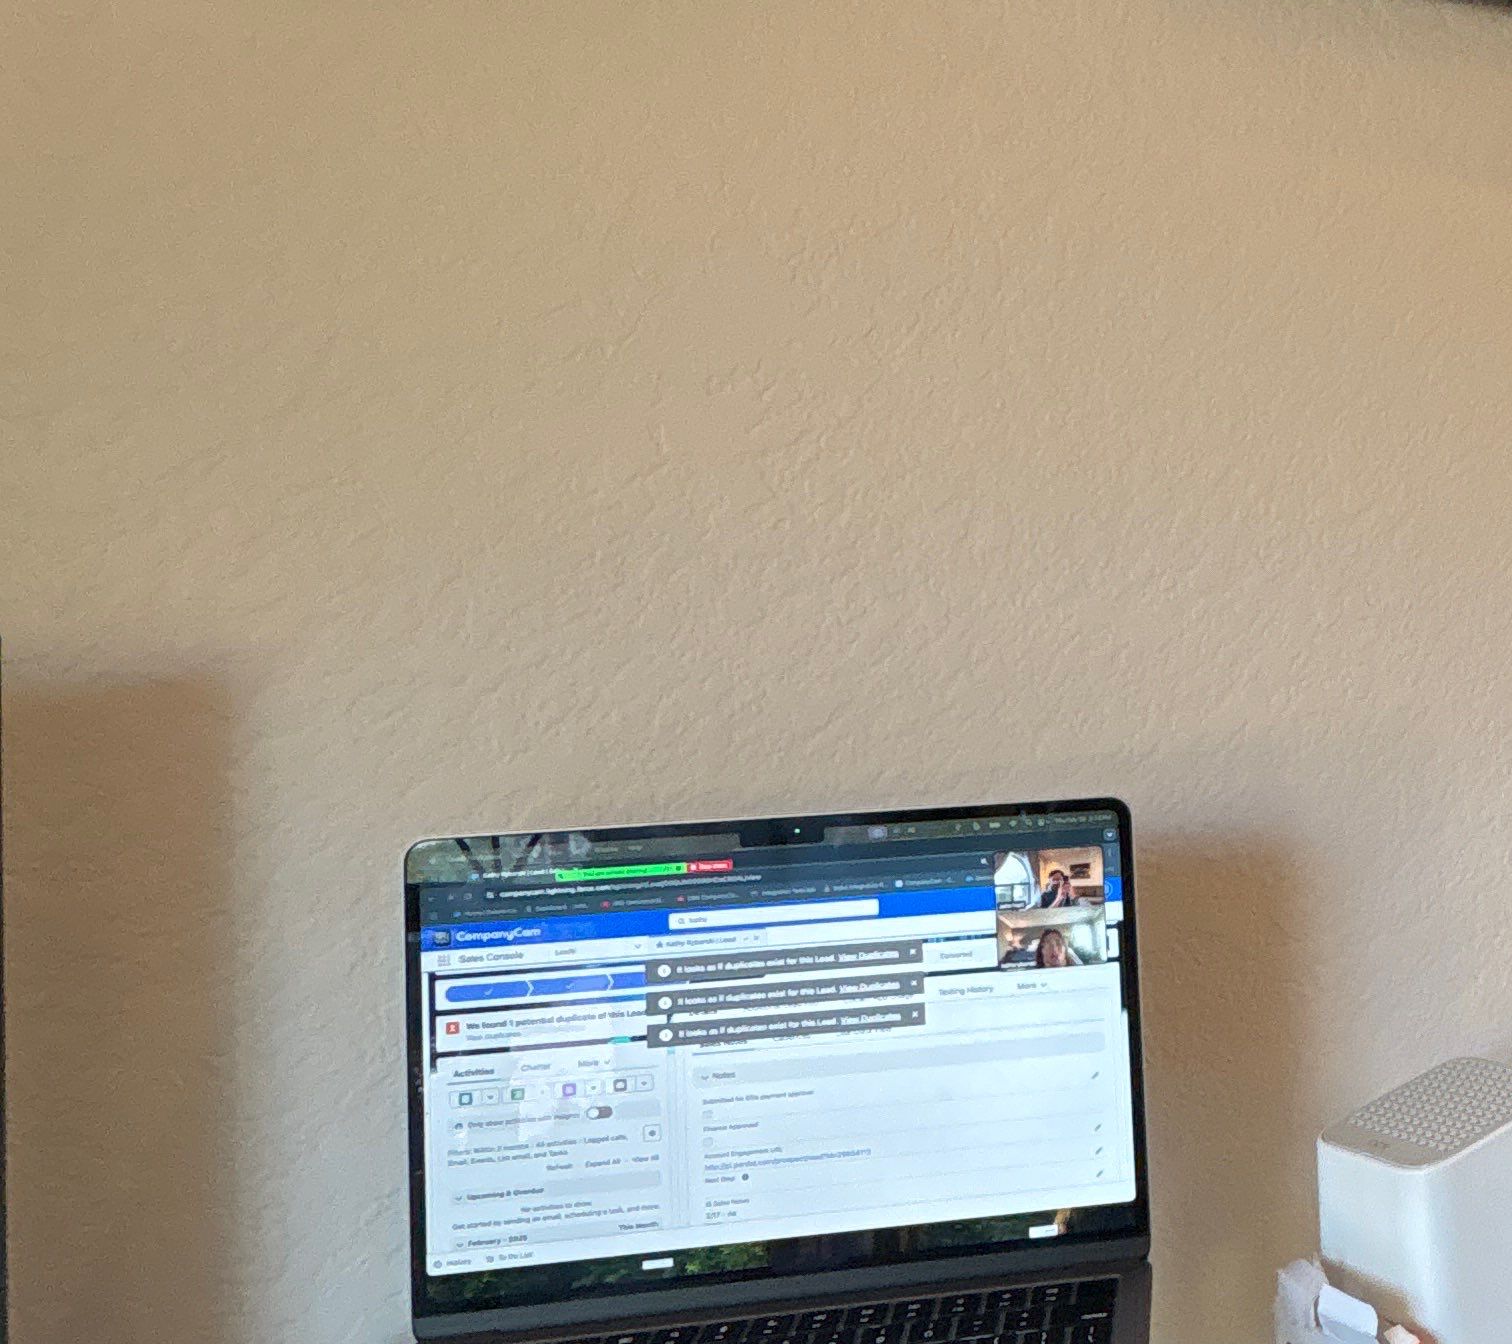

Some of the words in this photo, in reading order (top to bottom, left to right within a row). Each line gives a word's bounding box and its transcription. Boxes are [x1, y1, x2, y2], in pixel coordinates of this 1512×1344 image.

[455, 926, 541, 942] CompanyCam
[458, 953, 484, 964] Sales
[486, 950, 525, 962] Console
[453, 1067, 495, 1078] Activities
